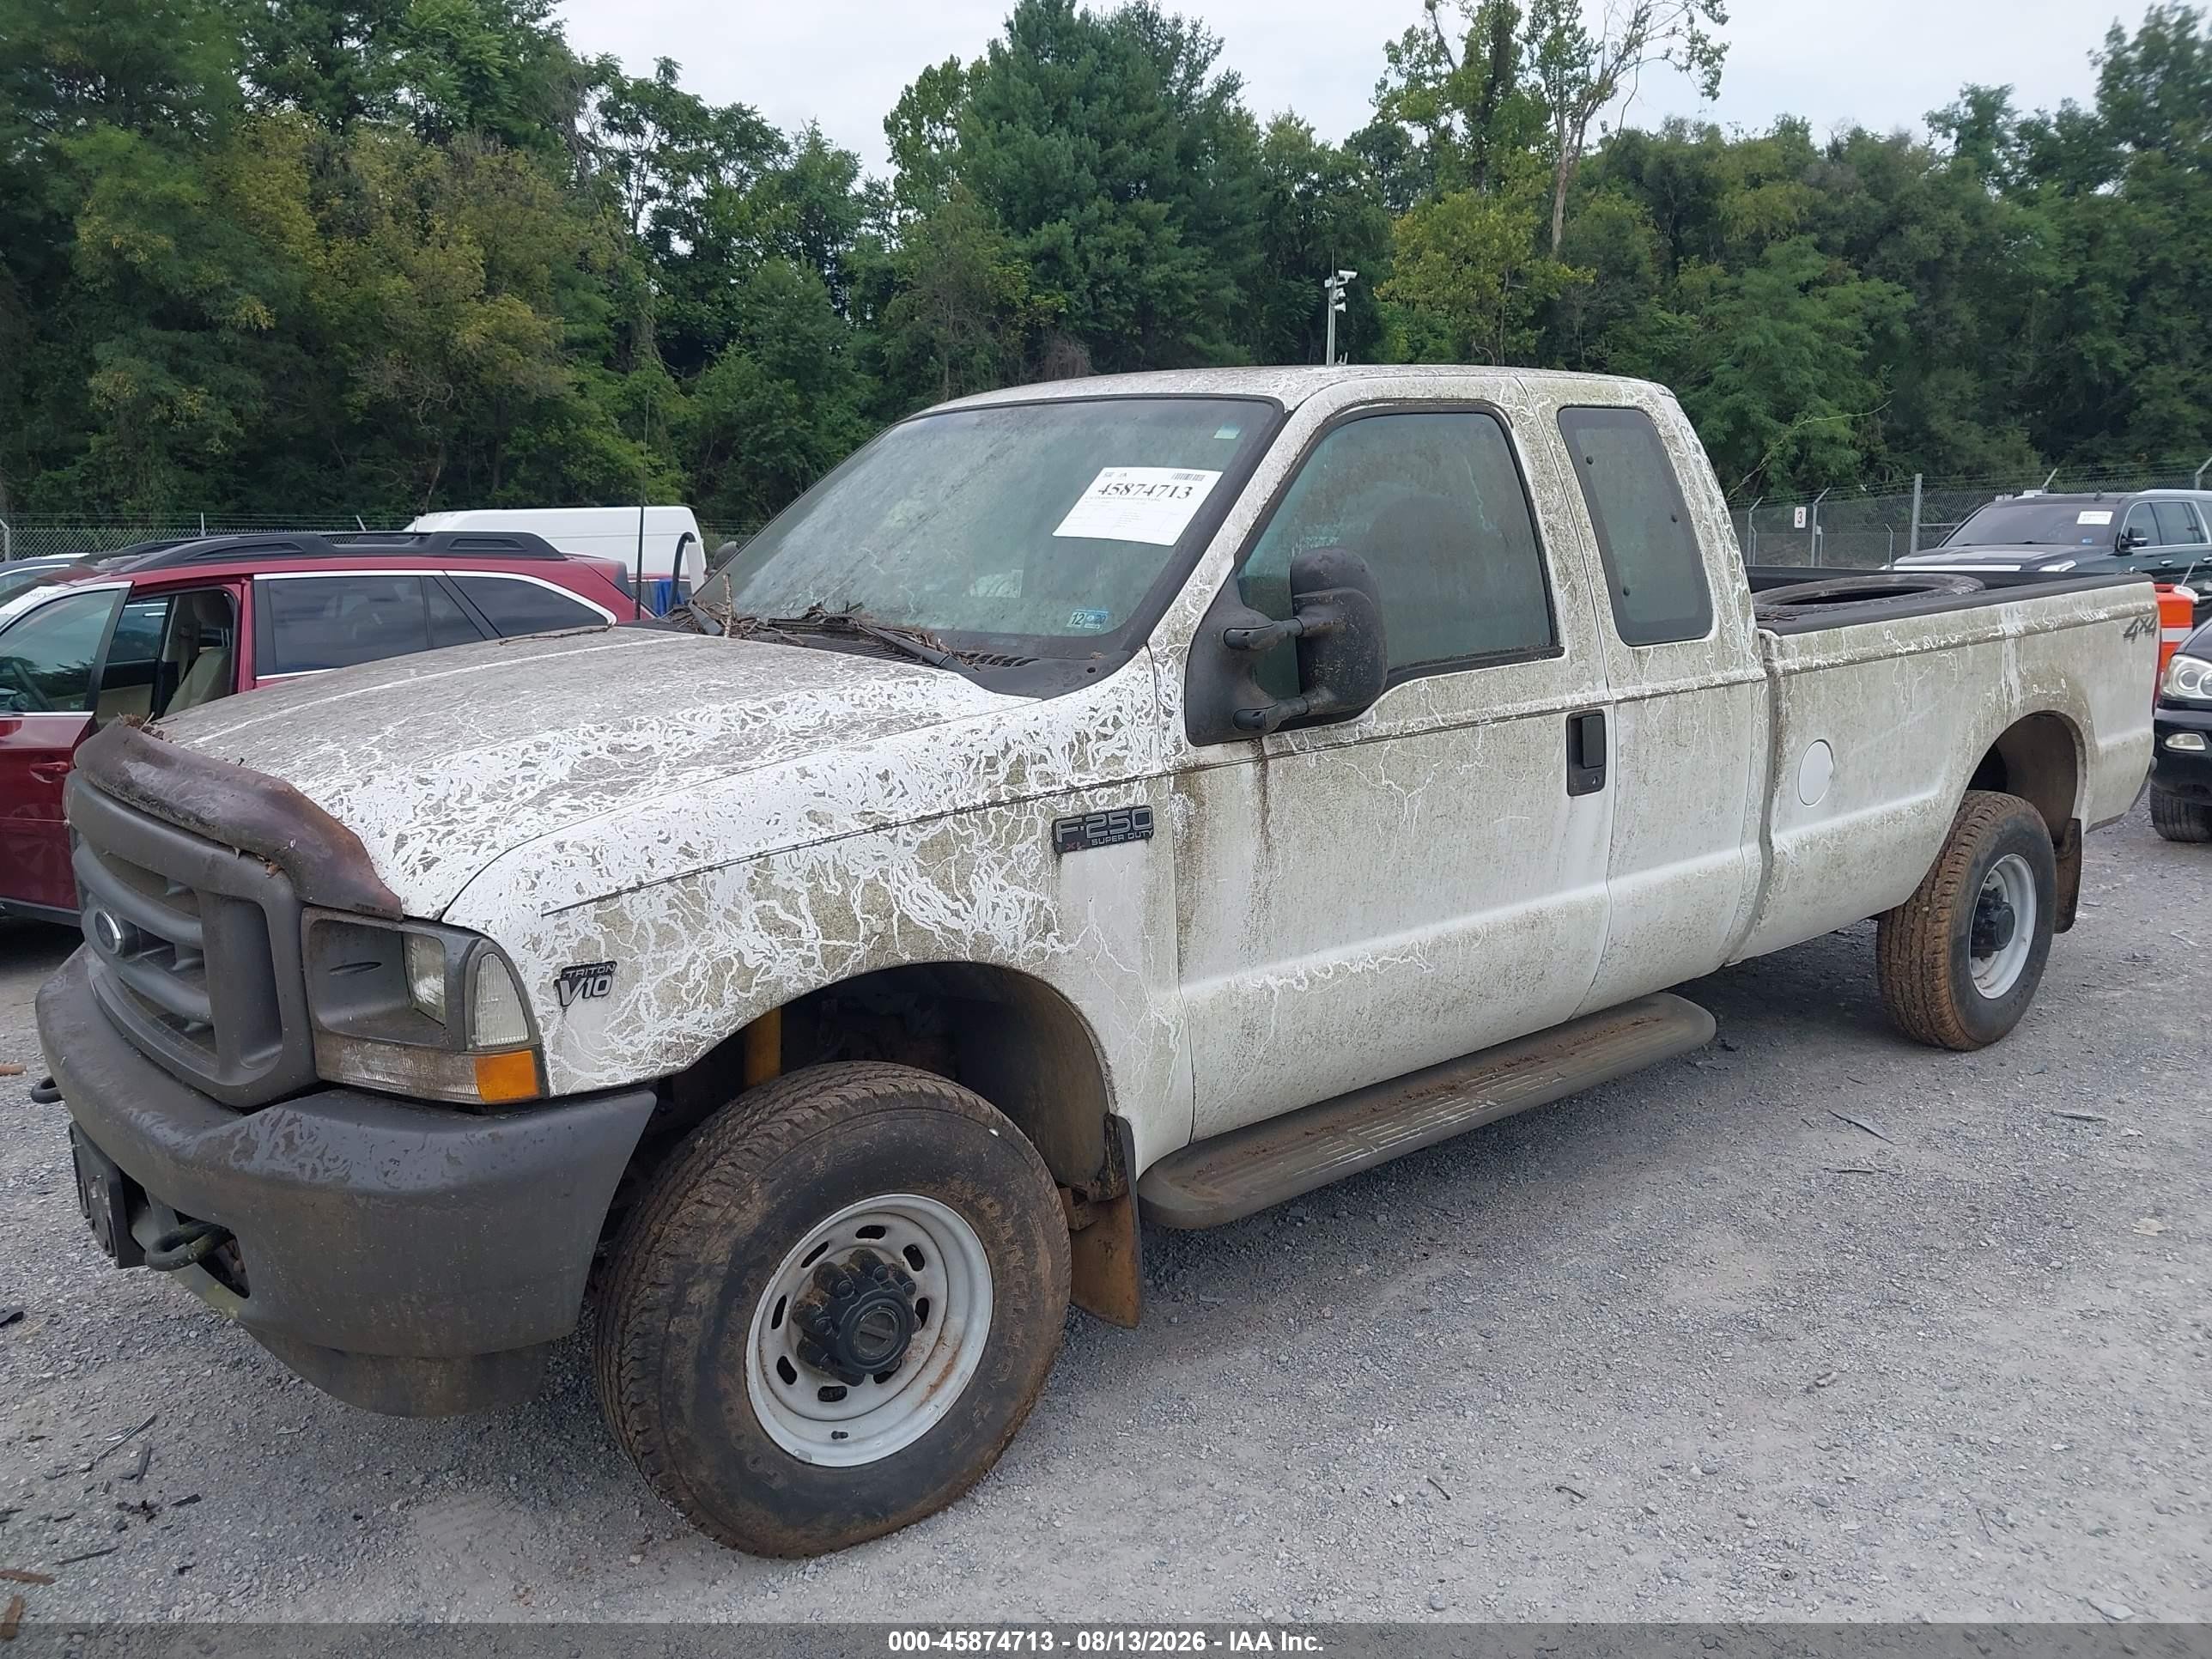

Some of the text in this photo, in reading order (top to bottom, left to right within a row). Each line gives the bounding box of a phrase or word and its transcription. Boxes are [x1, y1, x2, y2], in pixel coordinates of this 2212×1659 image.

[1097, 483, 1193, 499] 45874713
[1797, 510, 1803, 524] 3
[1071, 612, 1085, 625] 12
[1055, 807, 1152, 843] F-250
[1091, 829, 1154, 846] SUPER DUTY
[566, 963, 616, 978] TRITON
[559, 975, 612, 1007] V10
